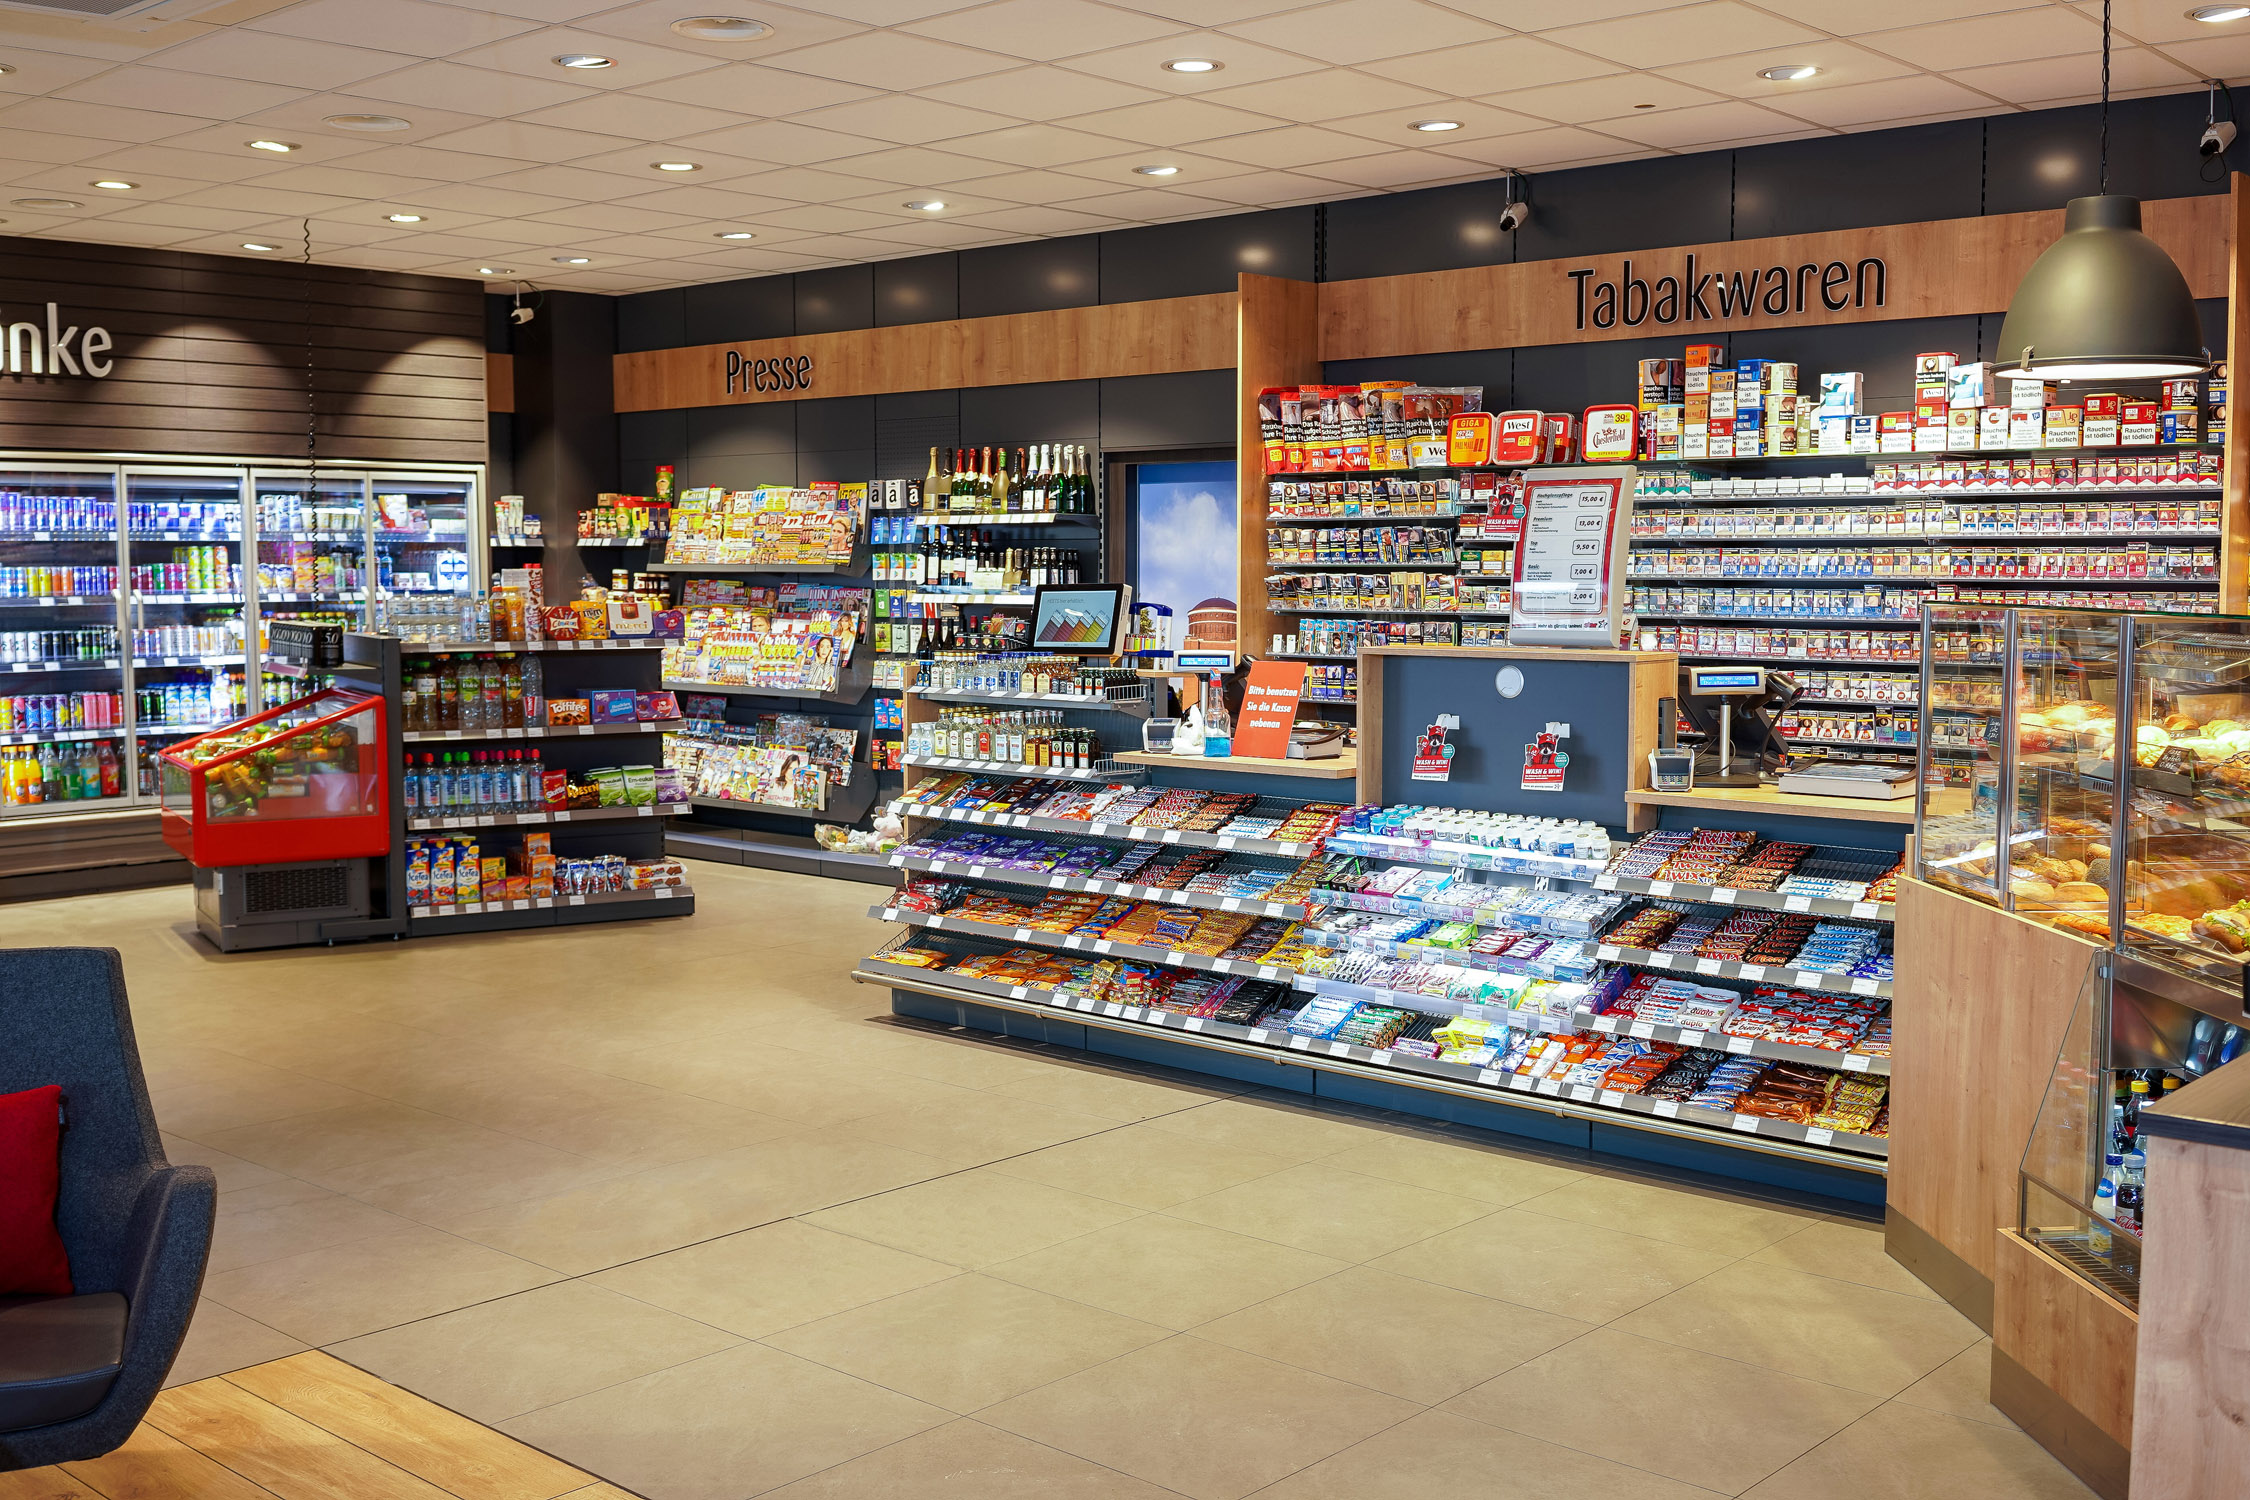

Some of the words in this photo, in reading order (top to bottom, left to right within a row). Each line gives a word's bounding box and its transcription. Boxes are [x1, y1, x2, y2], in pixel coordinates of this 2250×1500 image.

[1567, 253, 1887, 330] Tabakwaren
[0, 302, 113, 378] nke
[726, 350, 814, 395] Presse
[1460, 419, 1480, 427] GIGA
[1507, 419, 1531, 430] West
[1593, 428, 1626, 449] Chesterfield
[839, 590, 863, 599] INSIDE
[615, 620, 648, 629] merci
[1248, 685, 1265, 696] Bitte
[1265, 686, 1298, 697] benutzen
[550, 701, 587, 714] Toffifee
[1246, 701, 1258, 711] Sie
[1258, 701, 1270, 712] die
[1271, 702, 1292, 713] Kasse
[1249, 717, 1281, 729] nebenan
[1699, 831, 1737, 845] TWIX
[1748, 860, 1795, 869] Mars
[407, 871, 429, 880] IceTea
[432, 870, 453, 879] IceTea
[459, 868, 479, 878] IceTea
[1665, 869, 1700, 881] TWIX
[1740, 910, 1780, 921] TWIX
[1827, 924, 1868, 933] BOUNTY
[1749, 954, 1787, 963] Mars
[1681, 1019, 1704, 1028] duplo
[1738, 1023, 1764, 1031] bueno
[1862, 1042, 1889, 1050] hanuta
[1606, 1080, 1640, 1090] Balisto
[1844, 1082, 1876, 1095] LION
[1840, 1103, 1870, 1113] LION
